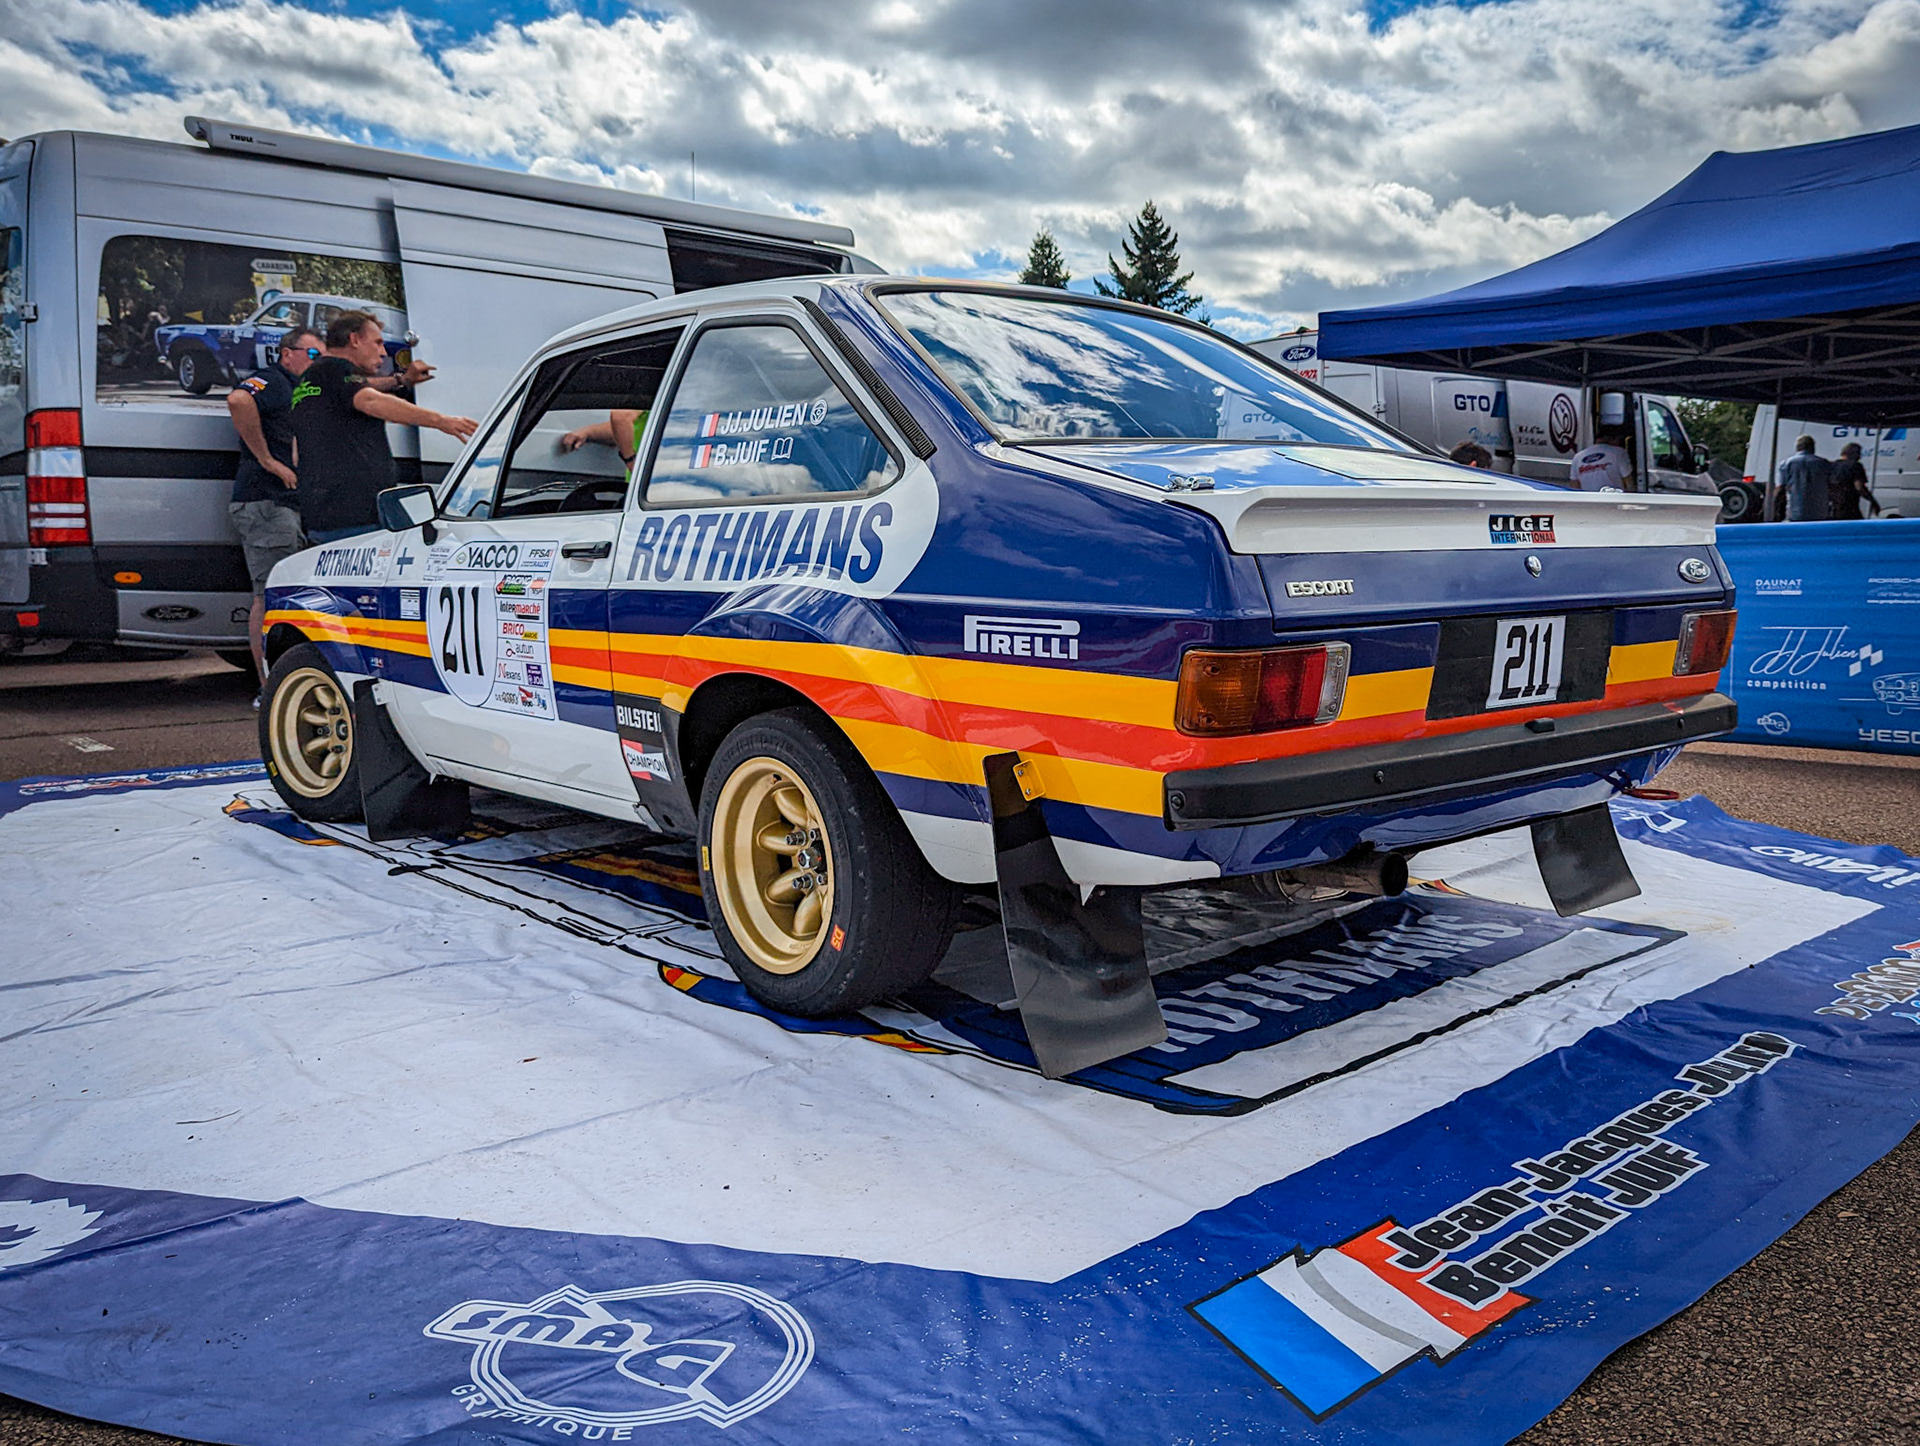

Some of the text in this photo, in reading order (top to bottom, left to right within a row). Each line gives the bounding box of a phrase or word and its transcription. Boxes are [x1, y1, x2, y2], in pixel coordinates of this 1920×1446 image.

[230, 133, 253, 143] THULE
[1454, 394, 1490, 412] GTO
[1243, 413, 1273, 423] GTO
[713, 438, 769, 467] B.JUIF
[1492, 517, 1550, 531] JIGE
[627, 501, 893, 583] ROTHMANS
[1491, 533, 1555, 543] INTERNATIONAL
[314, 547, 377, 576] ROTHMANS
[468, 545, 518, 568] YACCO
[1285, 579, 1354, 597] ESCORT
[440, 584, 484, 676] 211
[503, 622, 524, 636] BRICO
[964, 614, 1080, 660] PIRELLI
[498, 663, 521, 680] Nexans
[1498, 622, 1553, 700] 211
[626, 752, 667, 772] CHAMPION
[1384, 1088, 1708, 1271] Jean-Jacques
[1426, 1141, 1707, 1309] Benoît JUIF
[450, 1383, 634, 1442] GRAPHIQUE
